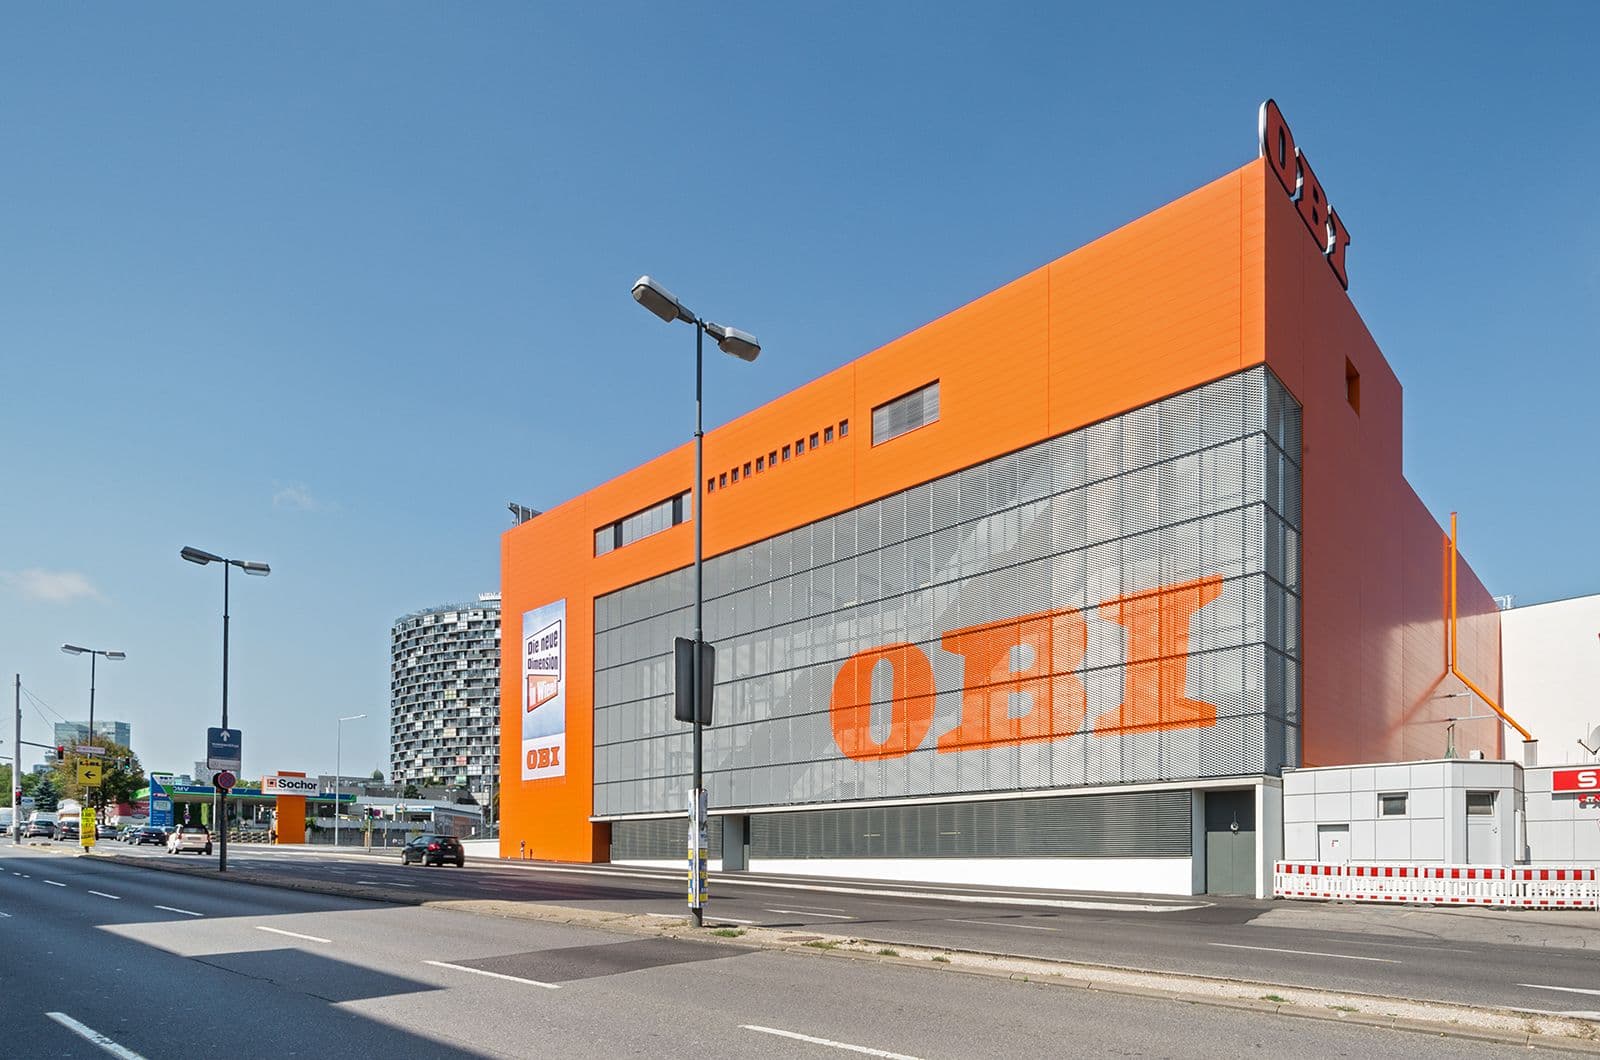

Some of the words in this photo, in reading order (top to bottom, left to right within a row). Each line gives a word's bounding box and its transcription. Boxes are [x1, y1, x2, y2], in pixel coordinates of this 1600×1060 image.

[1258, 98, 1351, 291] OBI
[527, 639, 539, 655] Die
[541, 630, 558, 651] neue
[527, 653, 558, 670] Dimension
[830, 573, 1223, 762] OBI
[527, 746, 560, 770] OBI
[278, 778, 317, 790] Sochor
